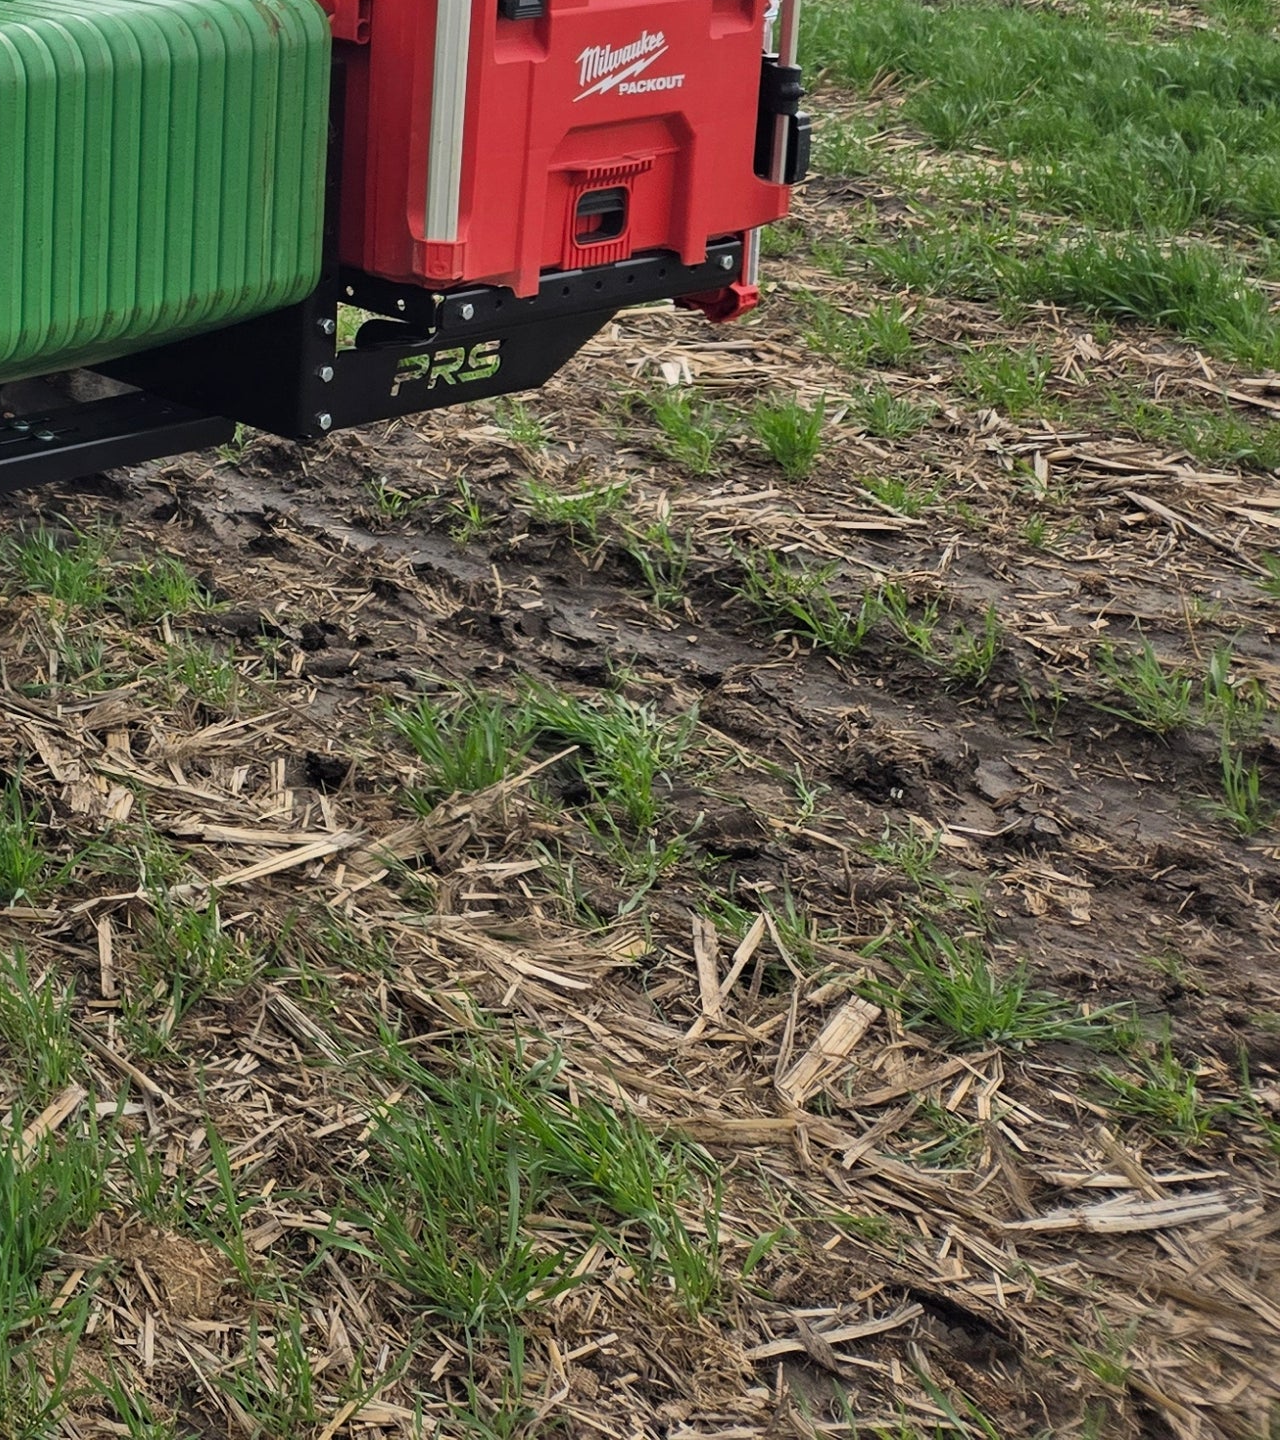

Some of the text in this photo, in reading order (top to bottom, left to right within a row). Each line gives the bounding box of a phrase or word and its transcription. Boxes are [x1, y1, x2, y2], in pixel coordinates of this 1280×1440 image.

[575, 30, 666, 87] Milwaukee
[618, 74, 686, 96] PACKOUT
[389, 339, 502, 397] PRS
